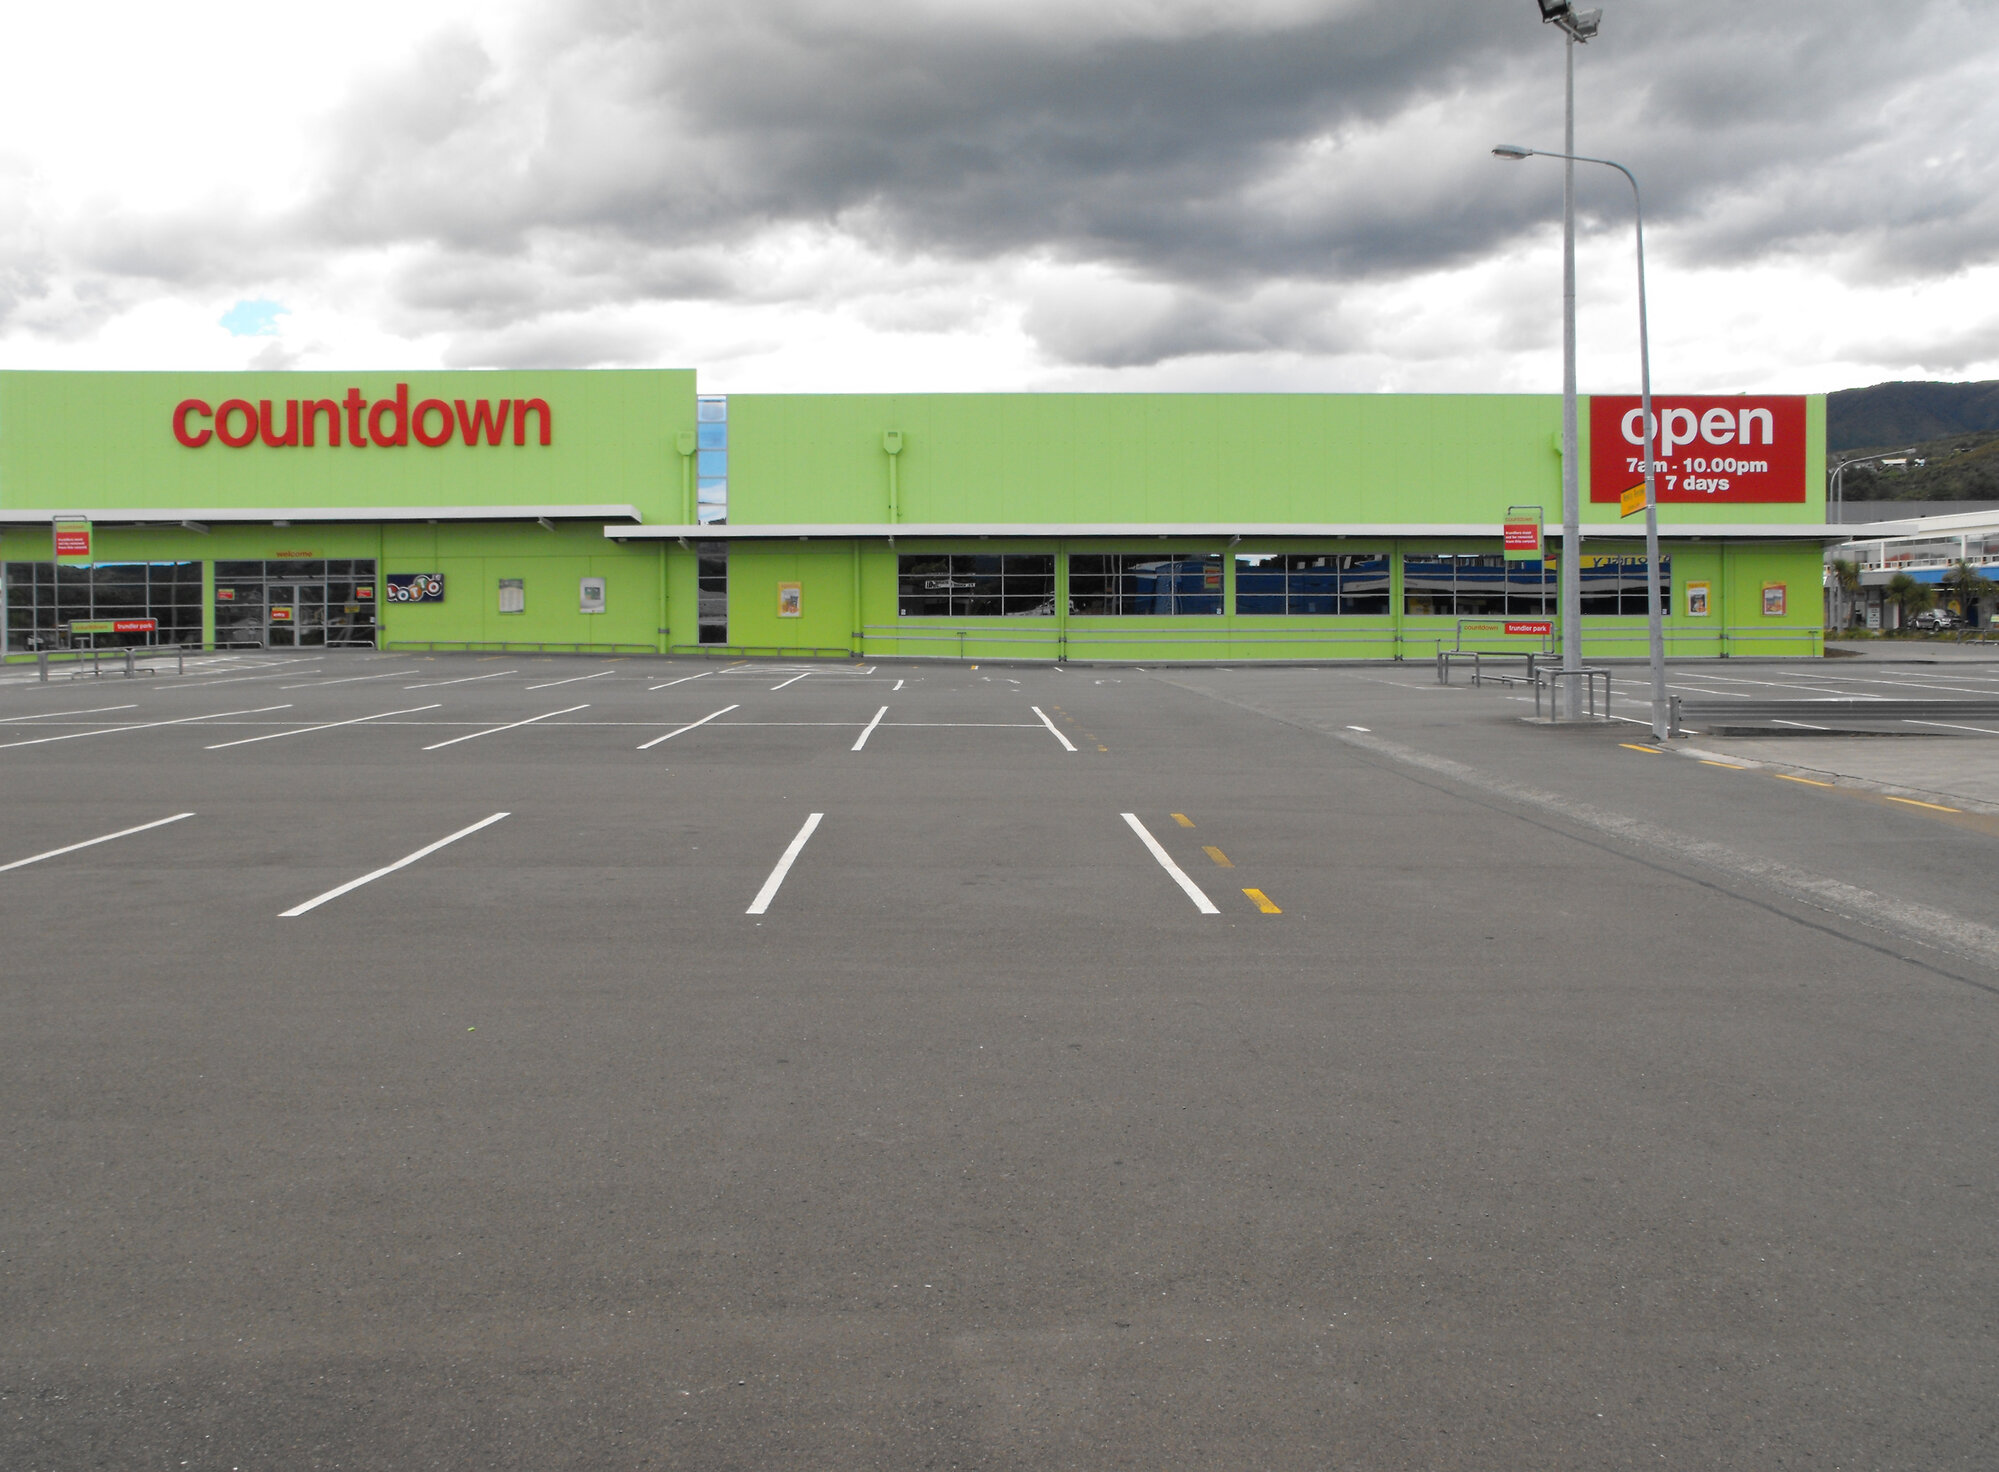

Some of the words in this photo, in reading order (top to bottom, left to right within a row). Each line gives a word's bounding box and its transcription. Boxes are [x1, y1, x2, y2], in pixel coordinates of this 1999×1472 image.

[172, 383, 552, 448] countdown
[1621, 407, 1774, 457] open
[1626, 458, 1668, 473] 7am
[1683, 457, 1768, 476] 10.00pm
[1665, 475, 1677, 490] 7
[1683, 475, 1730, 493] days
[387, 577, 440, 600] LOTTO
